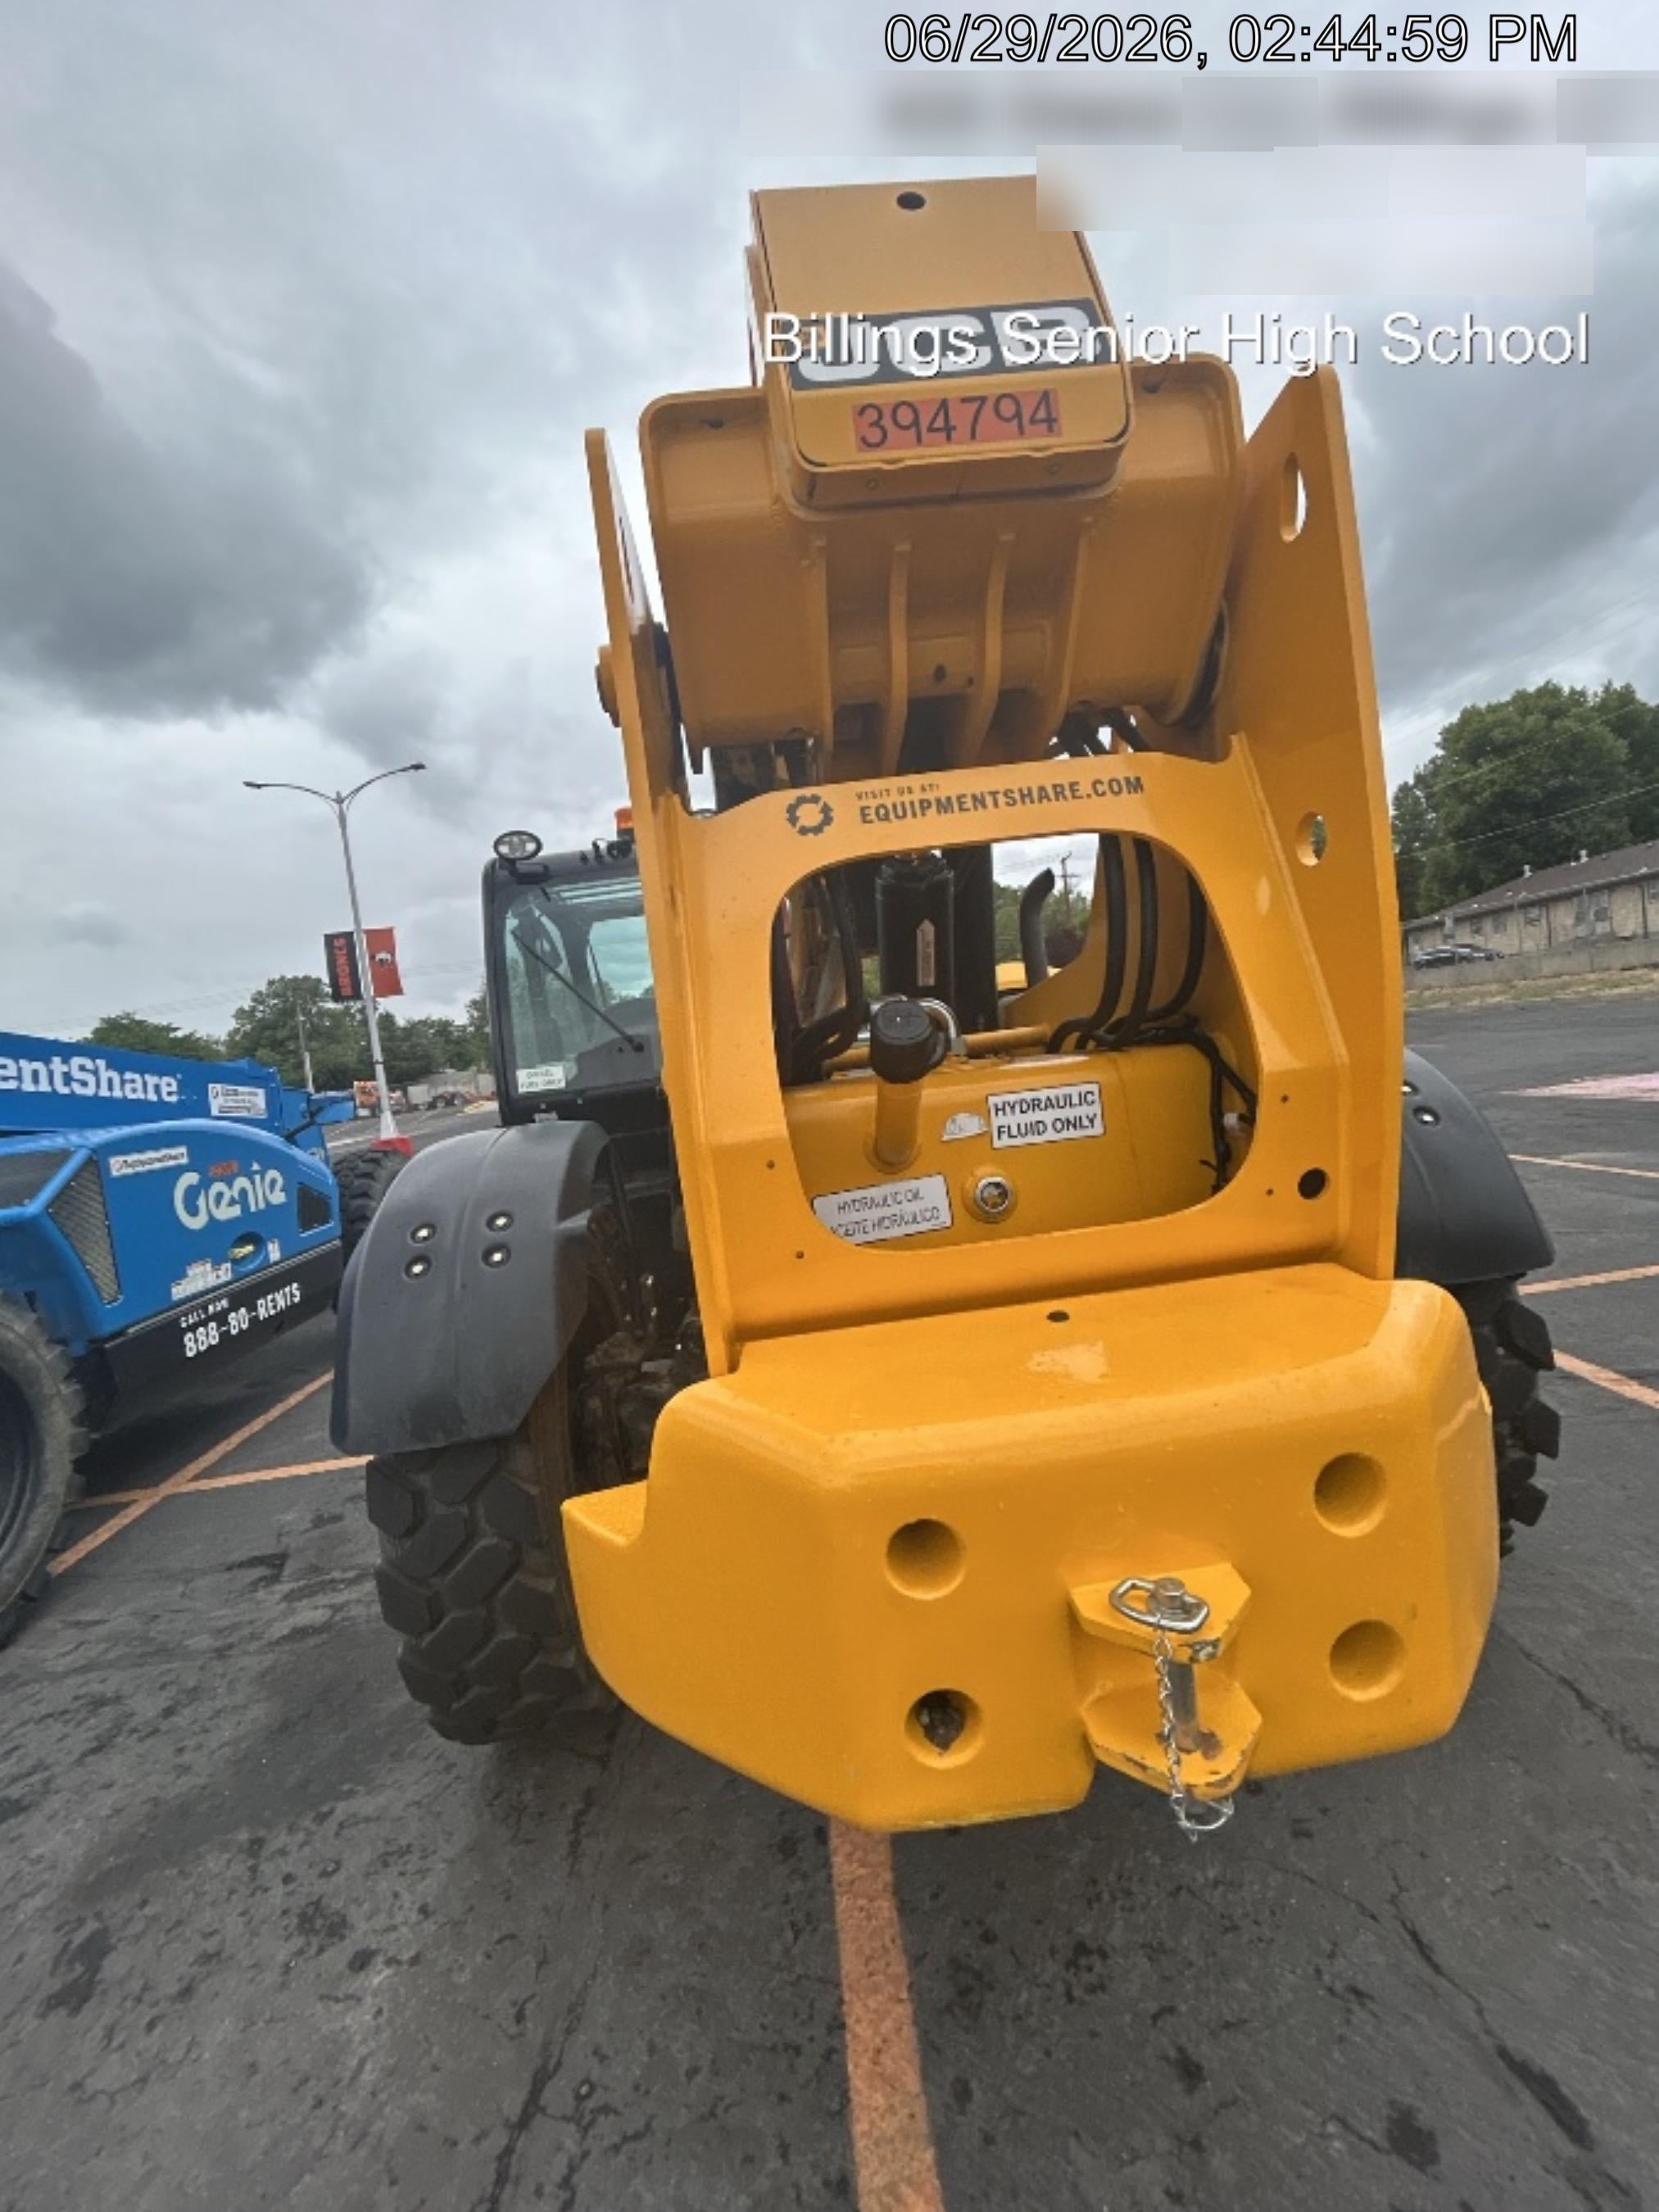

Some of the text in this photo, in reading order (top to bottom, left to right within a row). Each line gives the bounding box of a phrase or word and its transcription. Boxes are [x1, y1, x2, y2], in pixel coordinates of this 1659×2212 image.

[856, 389, 1059, 449] 394794
[855, 788, 891, 801] VISIT
[859, 775, 1144, 824] EQUIPMENTSHARE.COM
[993, 1090, 1095, 1117] HYDRAULIC
[997, 1120, 1048, 1141] FLUID
[1051, 1113, 1098, 1134] ONLY
[174, 1160, 287, 1230] Genie
[837, 1190, 903, 1215] HYDRAULIC
[183, 1282, 301, 1358] 888-80-RENTS
